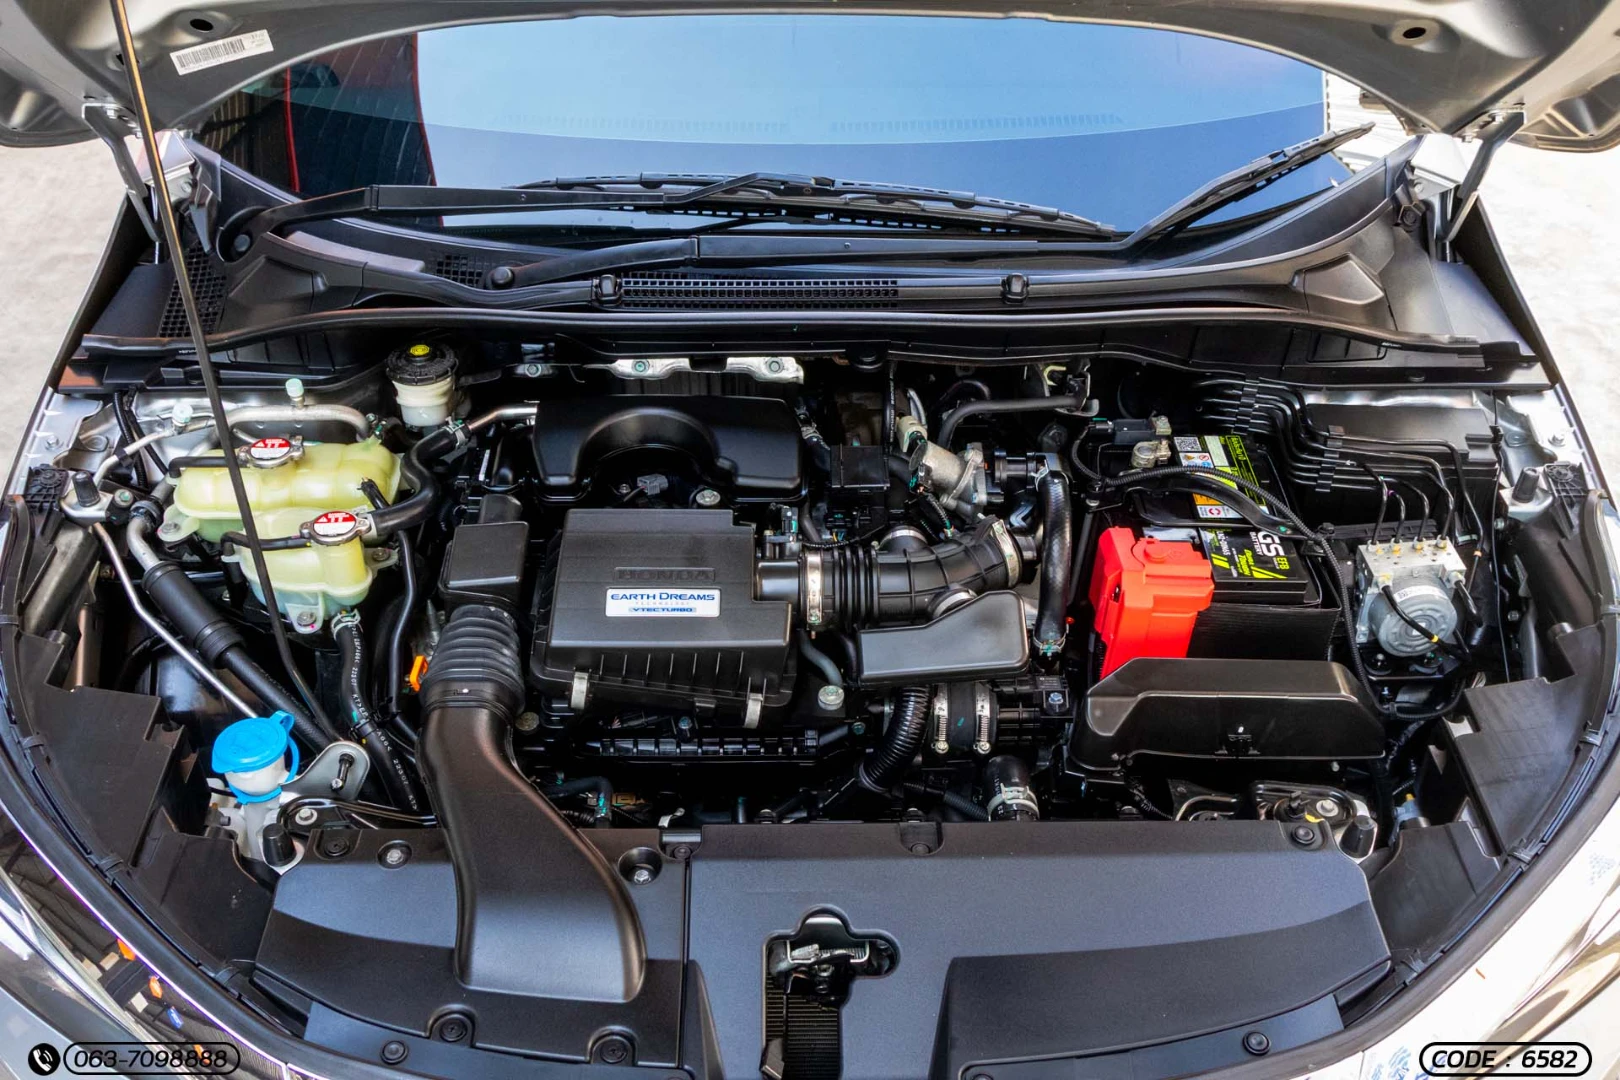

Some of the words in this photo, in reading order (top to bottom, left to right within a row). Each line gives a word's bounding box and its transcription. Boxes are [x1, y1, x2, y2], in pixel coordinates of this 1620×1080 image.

[1249, 531, 1263, 555] BATTERY
[1258, 531, 1285, 556] GS
[1276, 556, 1289, 569] EFB
[659, 592, 715, 600] DREAMS
